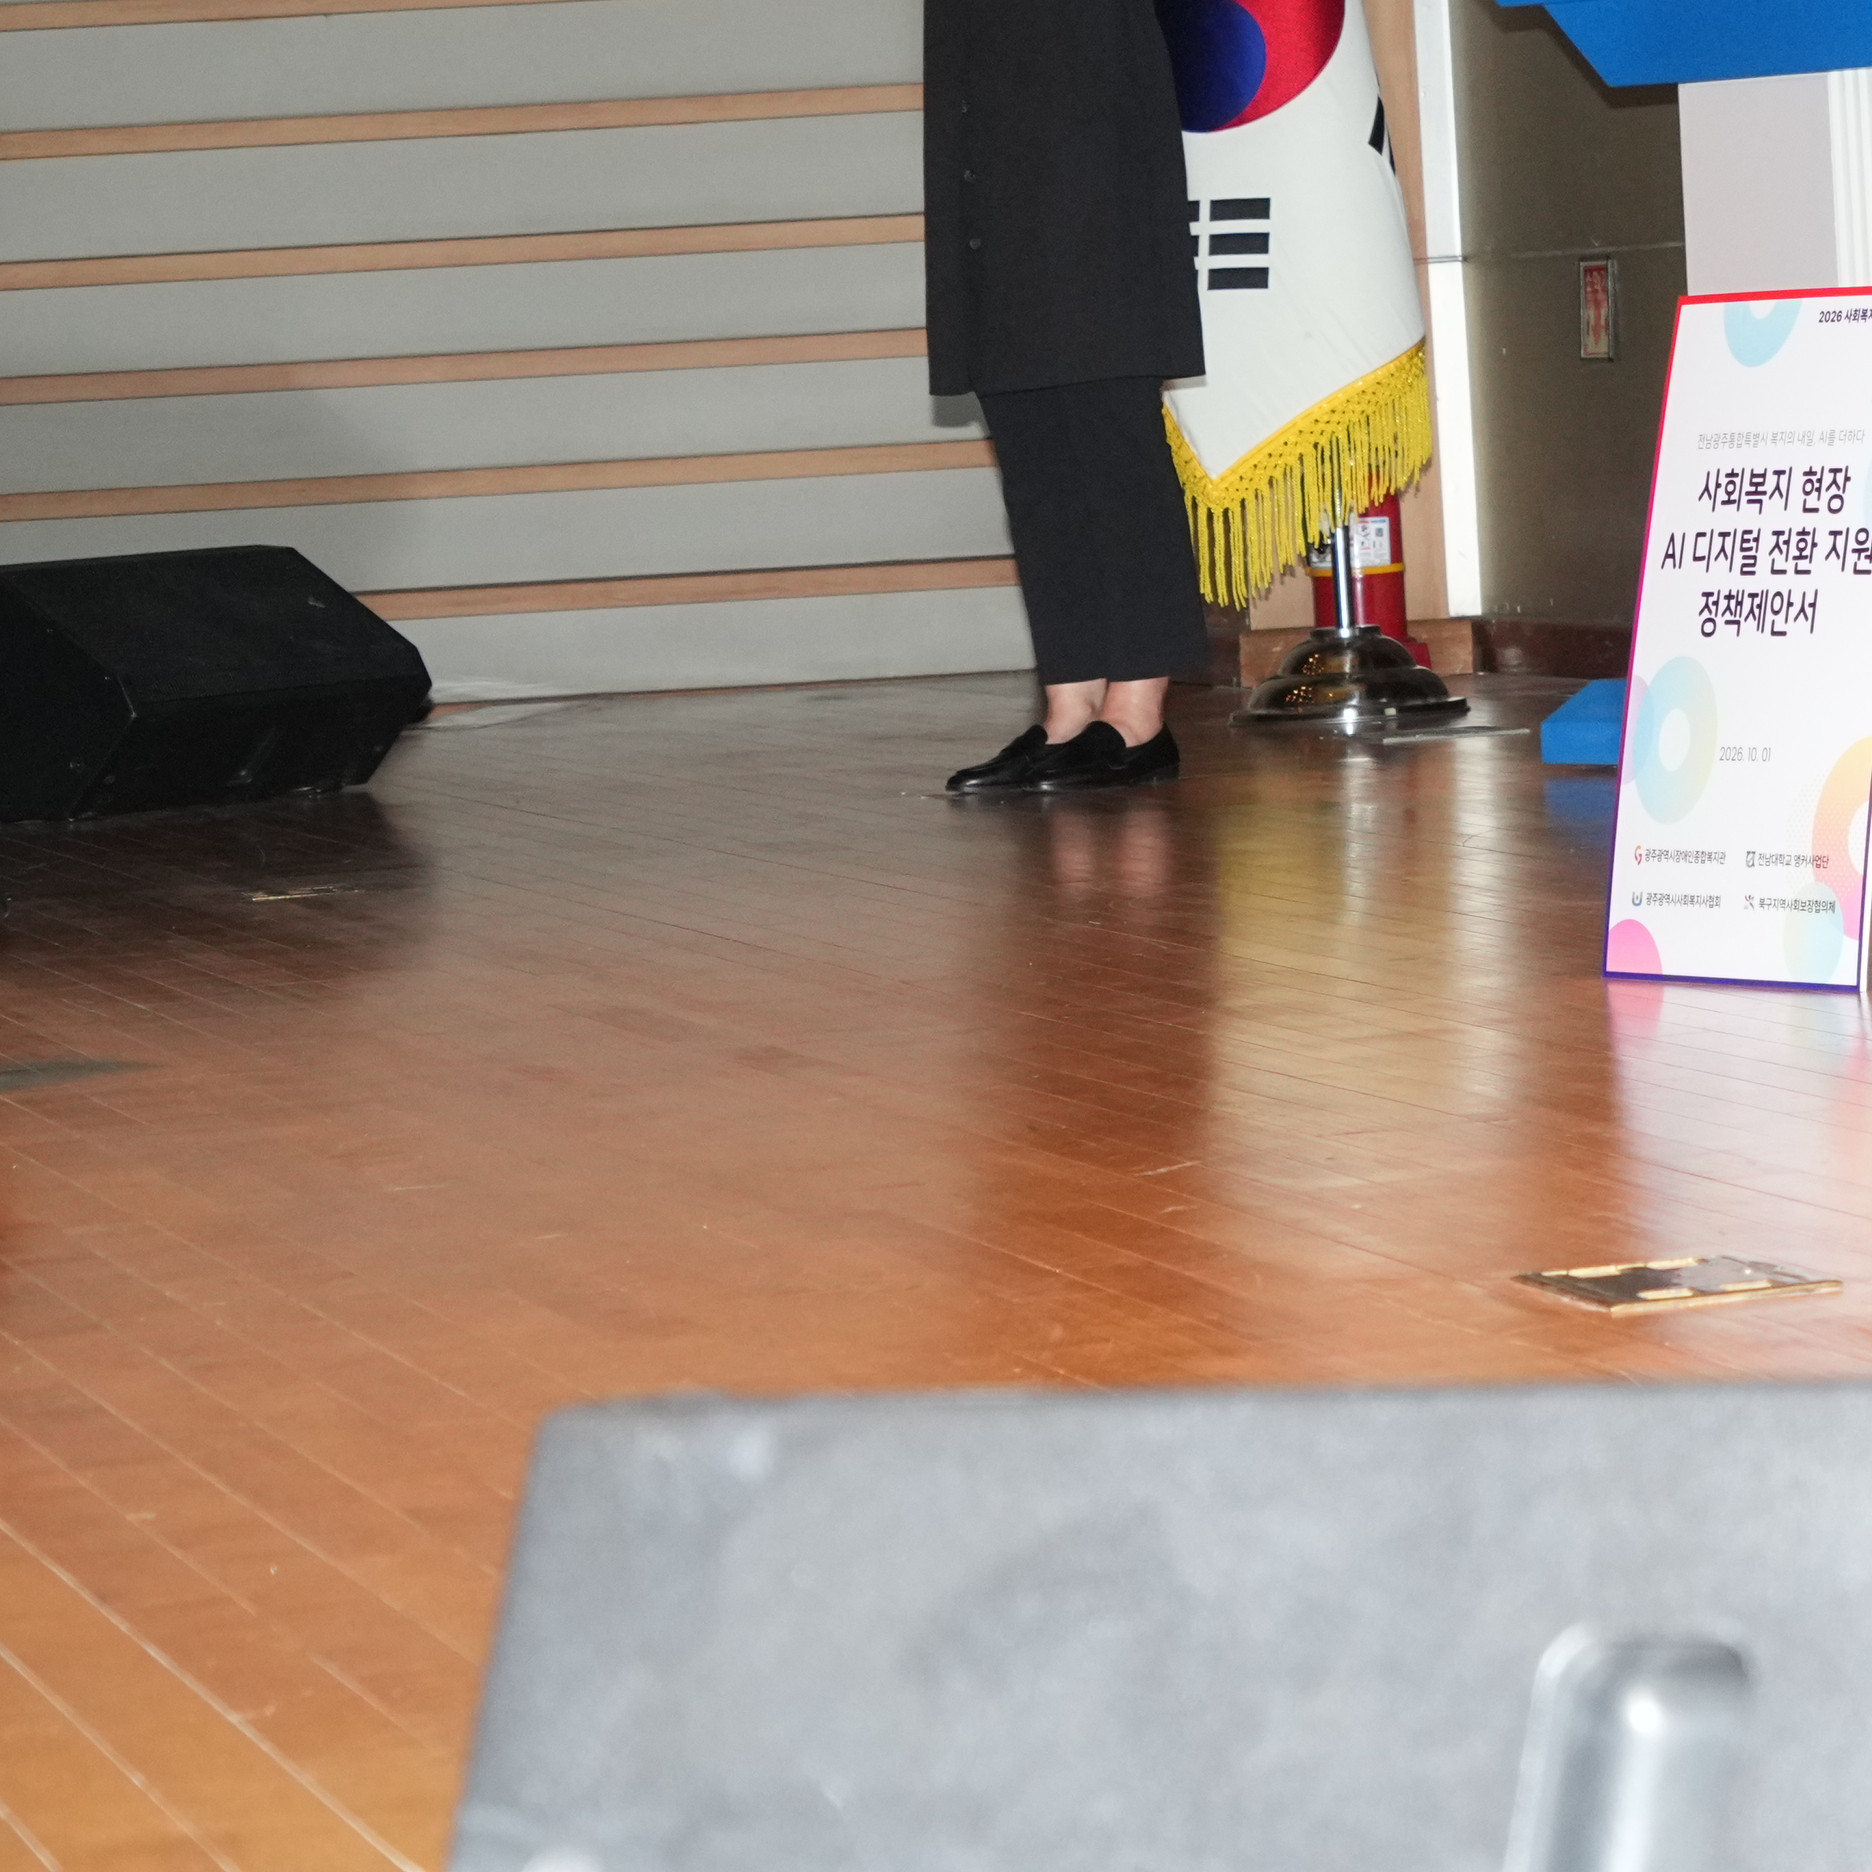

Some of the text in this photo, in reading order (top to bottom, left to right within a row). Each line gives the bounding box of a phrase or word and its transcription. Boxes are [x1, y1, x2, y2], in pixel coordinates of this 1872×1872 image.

[1818, 310, 1843, 323] 2026
[1697, 431, 1769, 450] 전남광주통합특별시
[1770, 430, 1796, 447] 복지의
[1838, 428, 1865, 445] 더하다
[1698, 465, 1851, 515] 사회복지 현장
[1661, 532, 1685, 570] AI
[1692, 528, 1761, 576] 디지털
[1768, 526, 1818, 576] 전환
[1698, 589, 1818, 638] 정책제안서
[1645, 848, 1727, 865] 광주광역시장애인종합복지관
[1758, 853, 1830, 869] 전남대학교 앵커사업단
[1646, 892, 1721, 909] 광주광역시사회복지사협회
[1758, 897, 1836, 915] 북구지역사회보장협의체
